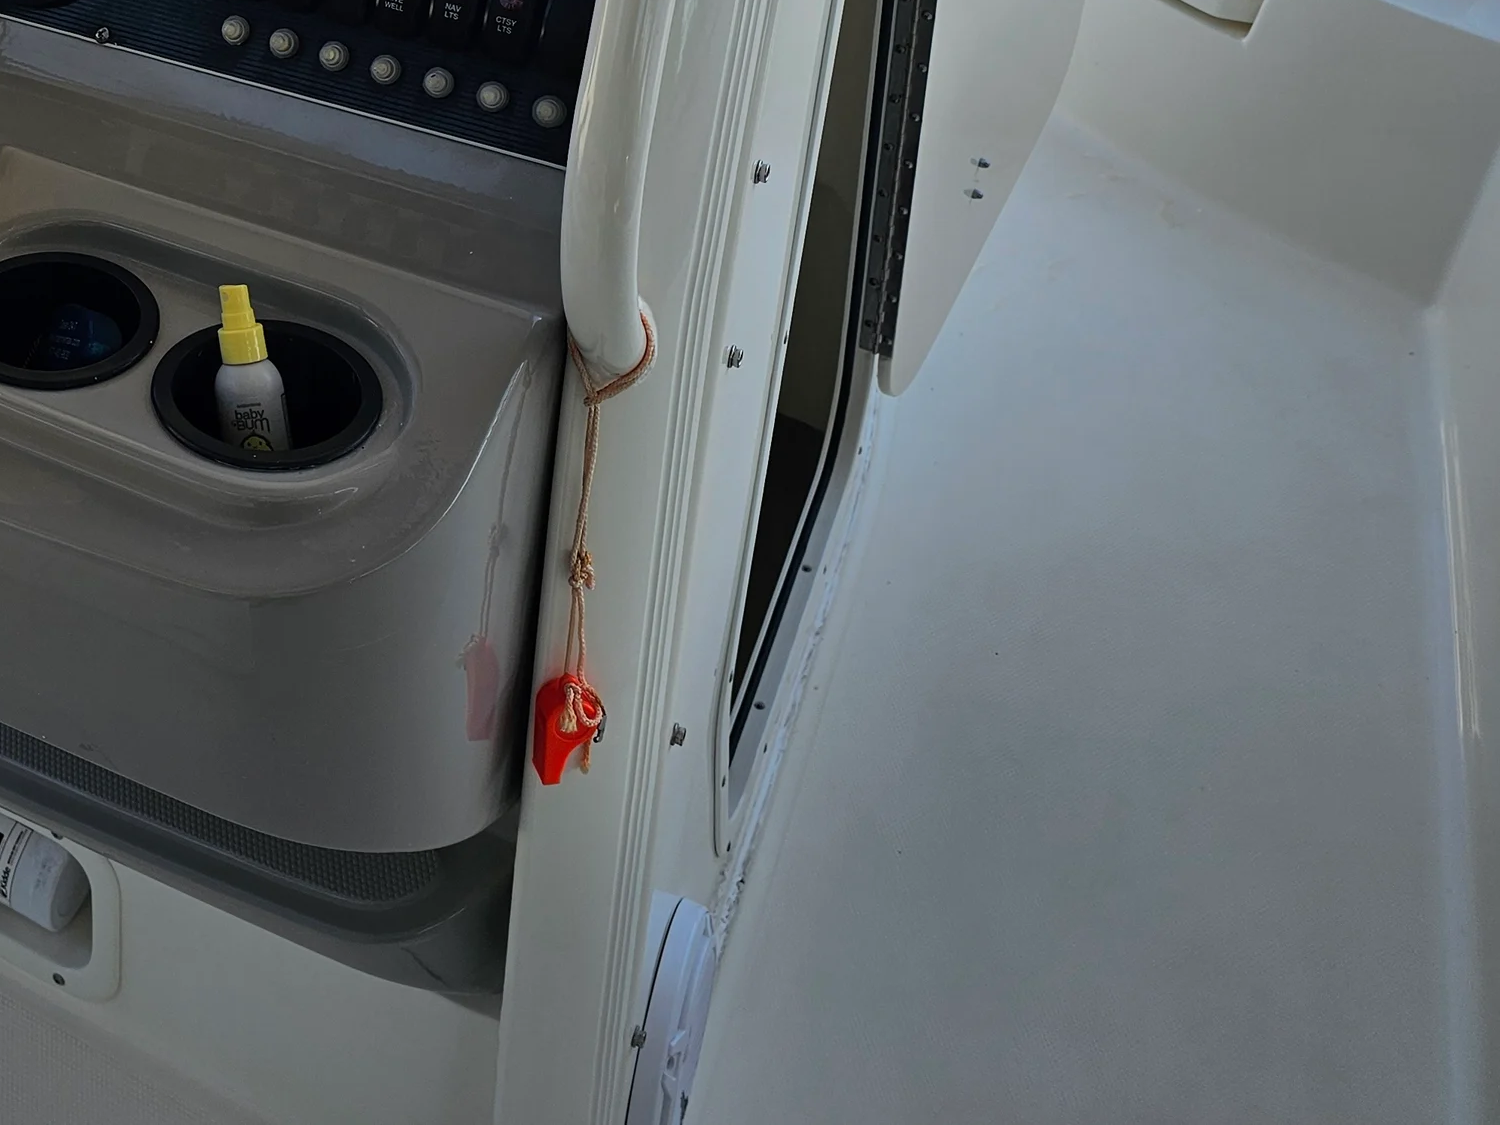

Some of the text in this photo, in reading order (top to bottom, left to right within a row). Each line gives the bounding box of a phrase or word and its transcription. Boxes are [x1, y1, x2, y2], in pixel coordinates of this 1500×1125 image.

[384, 0, 403, 12] WELL
[444, 2, 461, 12] NAV
[443, 10, 458, 20] LTS
[495, 15, 517, 26] CTSY
[496, 24, 511, 34] LTS
[234, 408, 264, 419] baby
